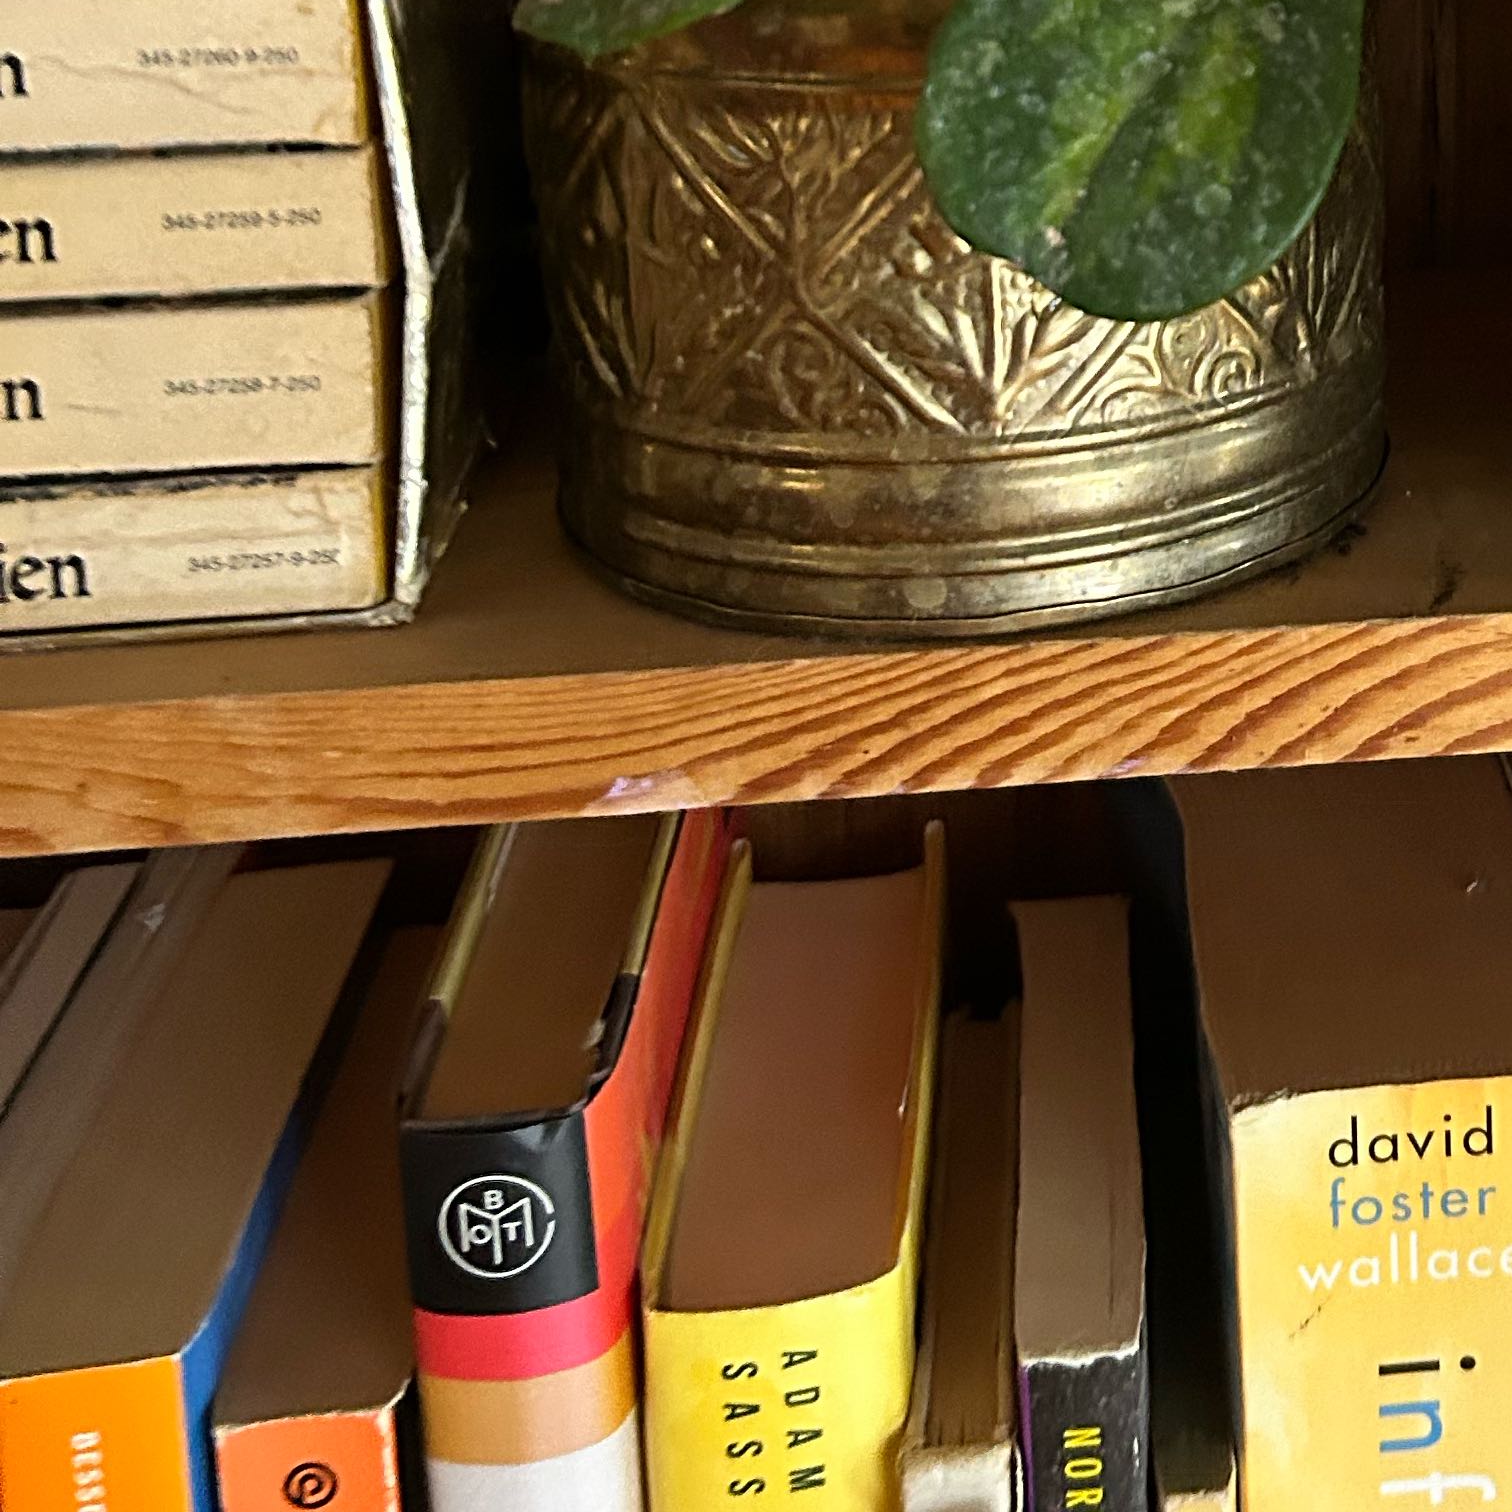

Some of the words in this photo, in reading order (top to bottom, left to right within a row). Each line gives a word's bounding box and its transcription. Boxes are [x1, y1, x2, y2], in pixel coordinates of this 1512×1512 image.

[1328, 1105, 1494, 1167] david
[1329, 1176, 1497, 1229] foster
[721, 1361, 766, 1497] SASS
[781, 1349, 826, 1493] ADAM
[1063, 1427, 1104, 1508] NOR
